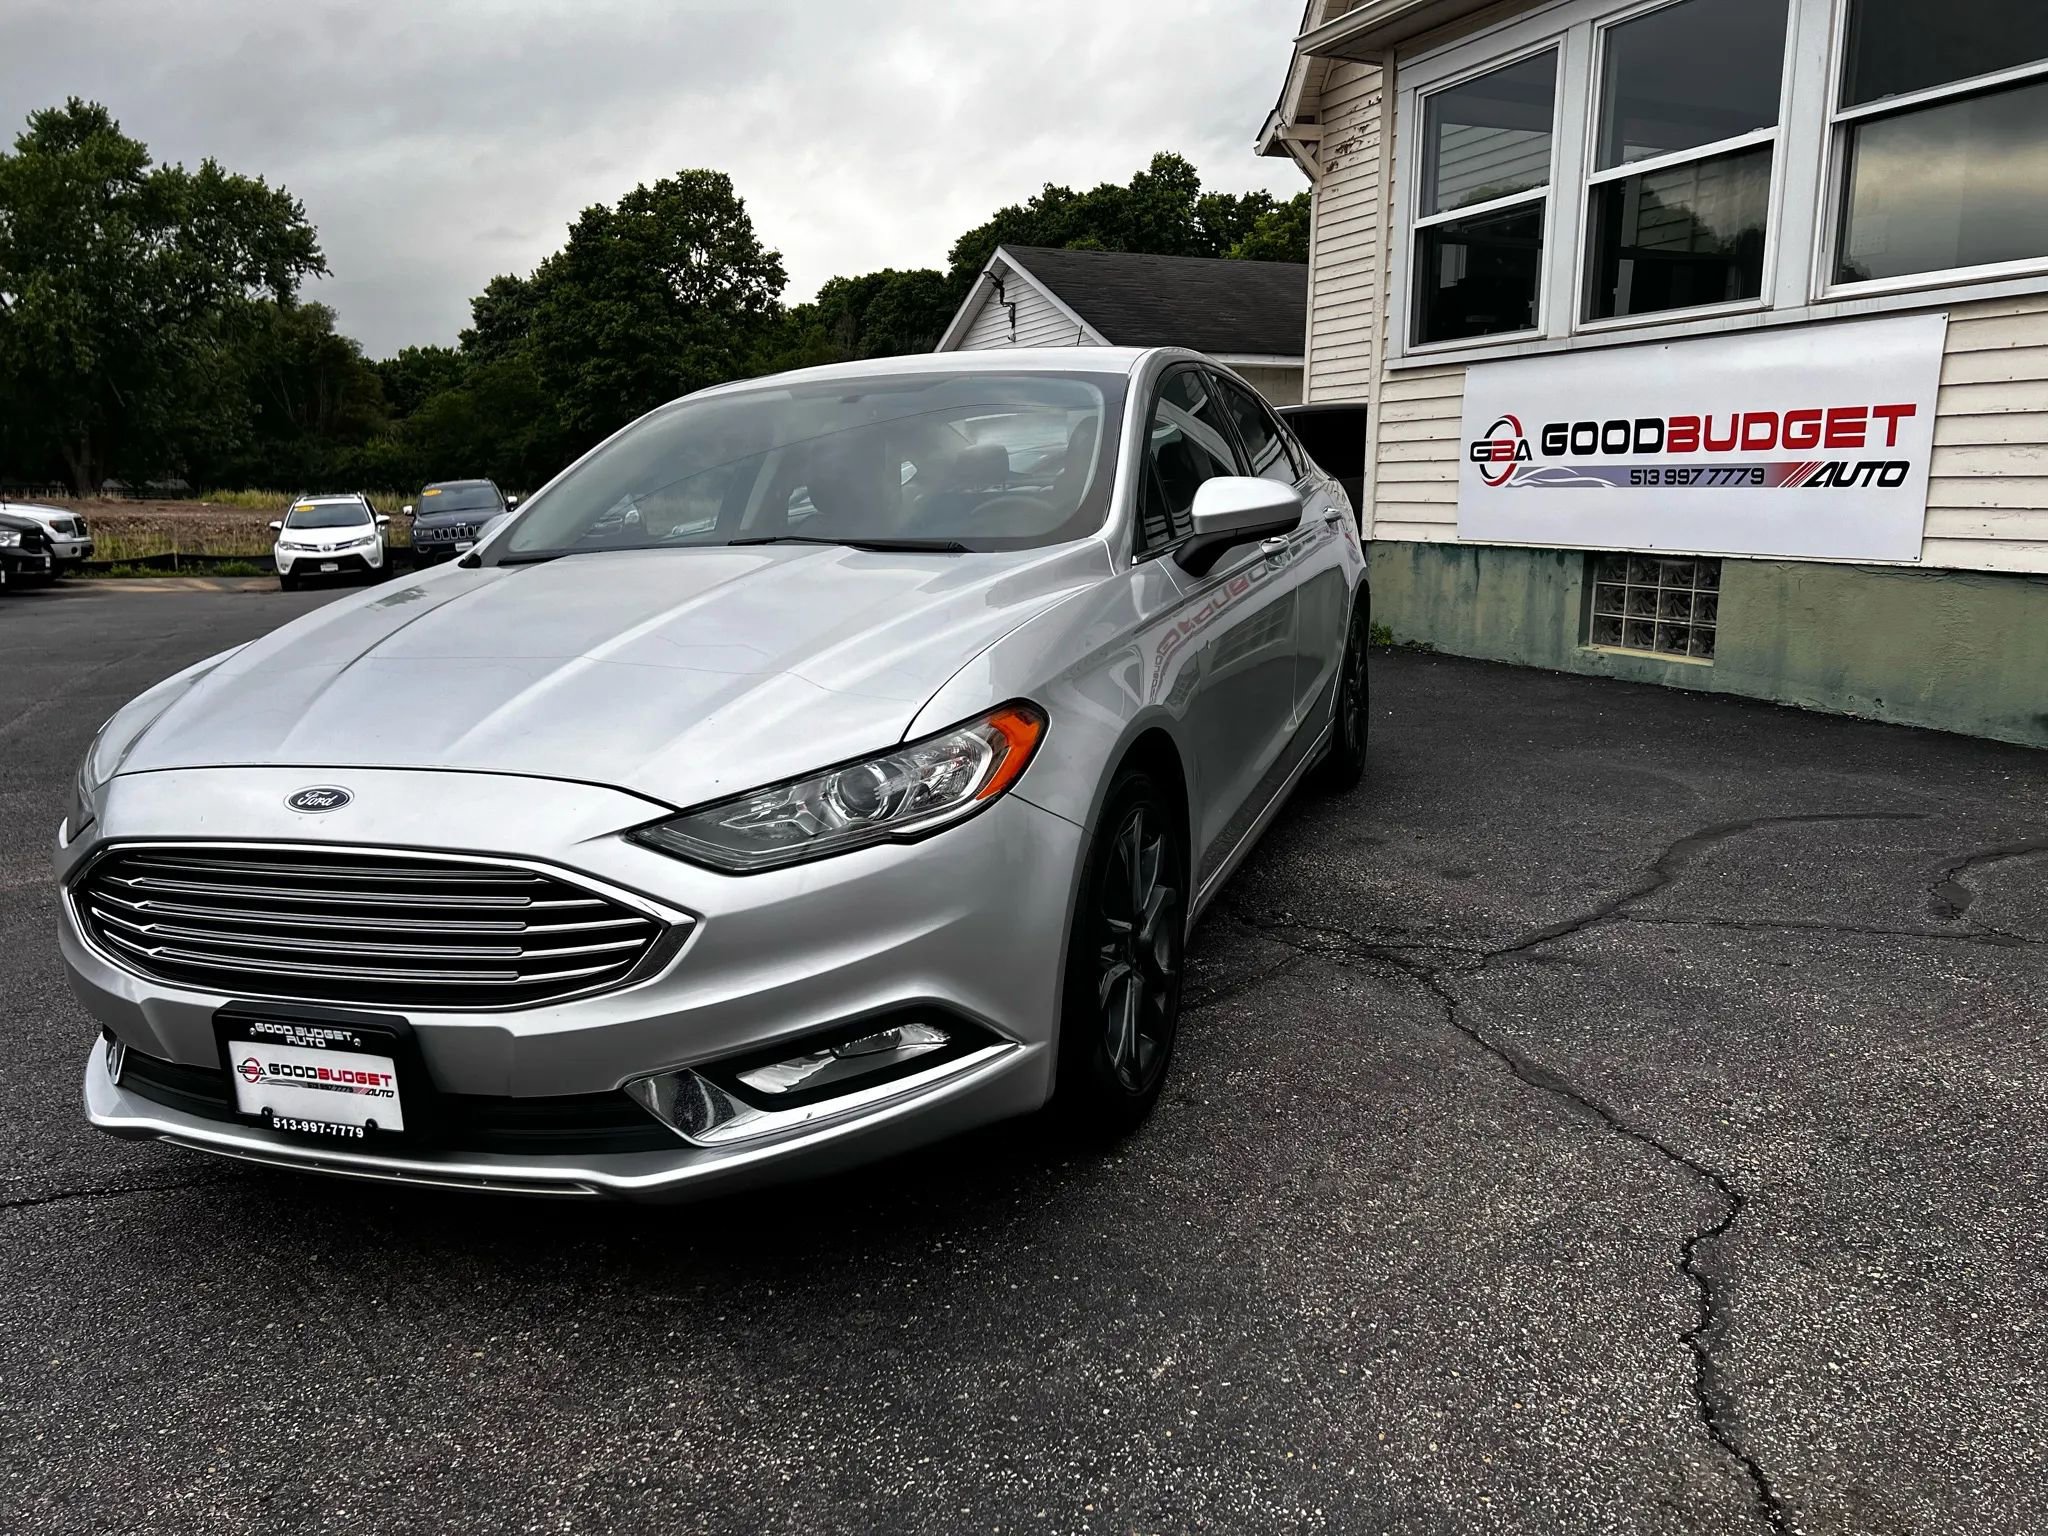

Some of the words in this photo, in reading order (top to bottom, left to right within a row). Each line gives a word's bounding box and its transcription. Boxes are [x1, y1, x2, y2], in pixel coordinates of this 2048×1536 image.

[1470, 439, 1533, 463] GBA
[1630, 469, 1660, 485] 513
[1664, 468, 1703, 485] 997
[1704, 468, 1765, 485] 7779
[1803, 460, 1911, 488] AUTO
[297, 791, 338, 806] Ford
[255, 1023, 293, 1035] GOOD
[296, 1027, 352, 1041] BUDGET
[286, 1036, 326, 1048] AUTO
[365, 1088, 394, 1098] AUTO
[273, 1117, 364, 1138] 513-997-7779
